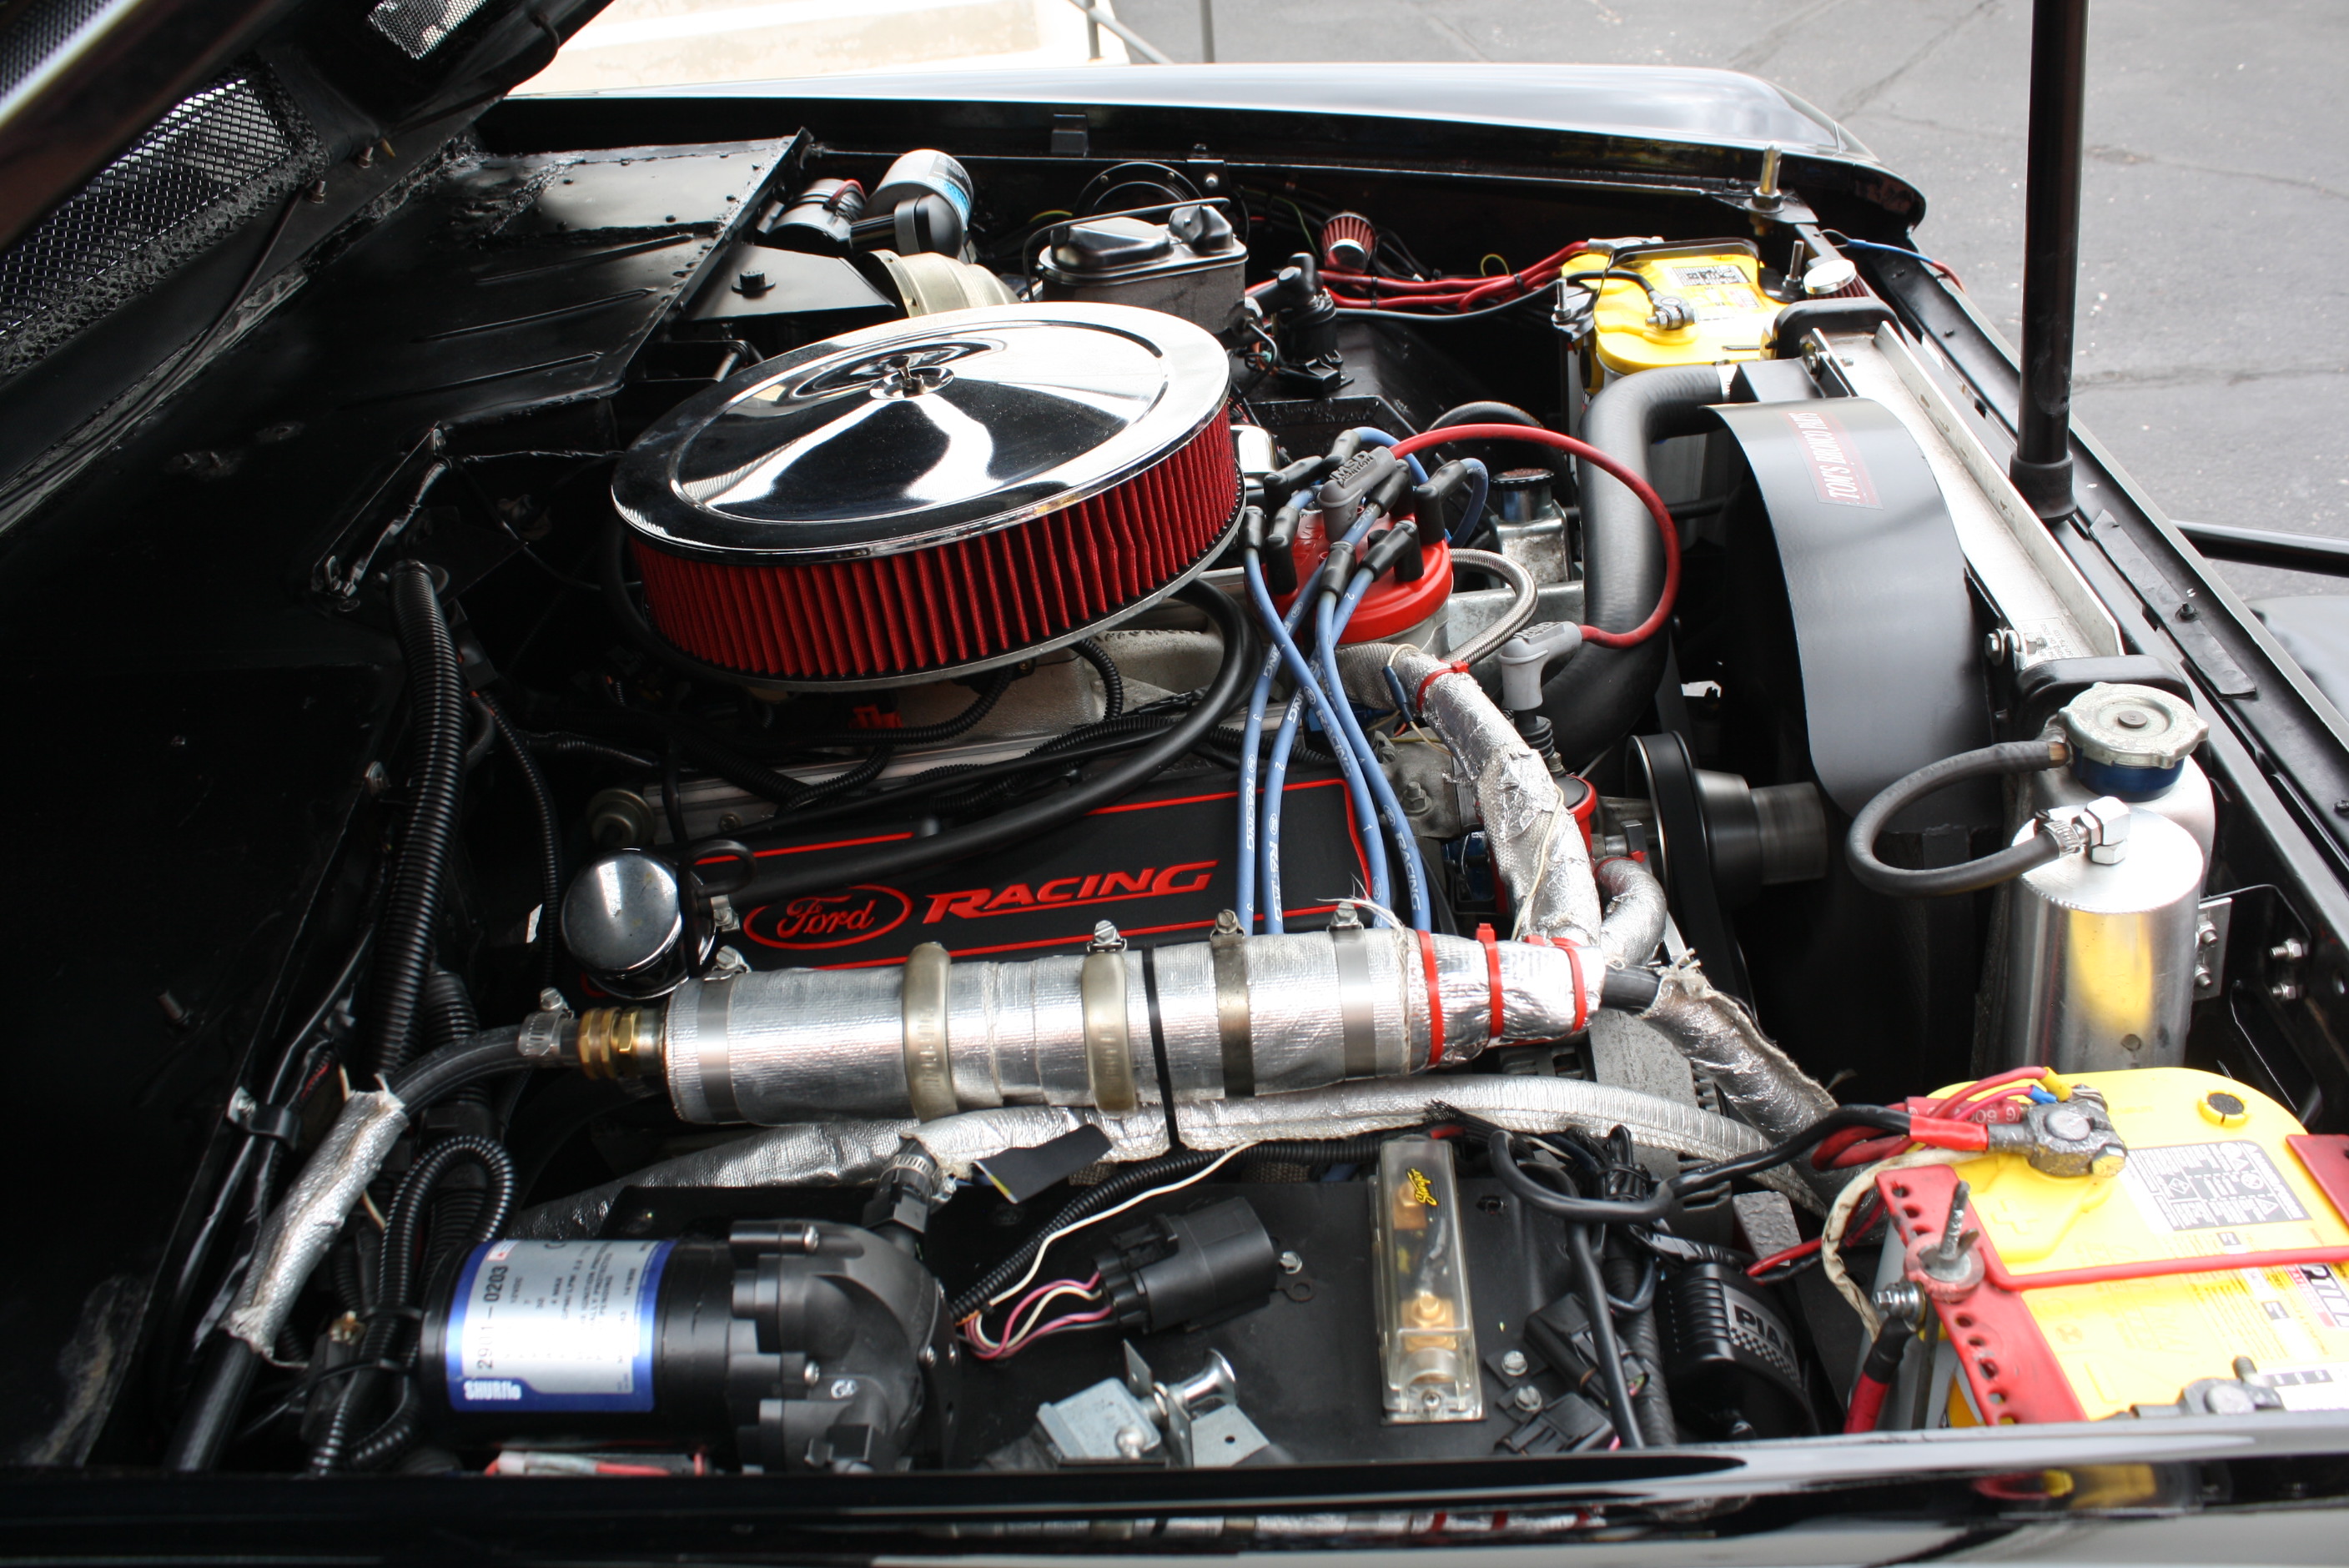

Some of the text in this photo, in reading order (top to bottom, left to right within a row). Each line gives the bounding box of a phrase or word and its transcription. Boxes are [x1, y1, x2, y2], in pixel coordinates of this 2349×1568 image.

[1330, 451, 1369, 481] MSD
[1788, 412, 1860, 500] TOM'S BRONCO PARTS
[1275, 761, 1285, 771] 2
[1245, 777, 1255, 853] RACING
[776, 859, 1219, 938] Ford RACING
[1269, 840, 1283, 925] RACING
[1394, 830, 1421, 911] RACING
[1733, 1304, 1797, 1368] PIAA
